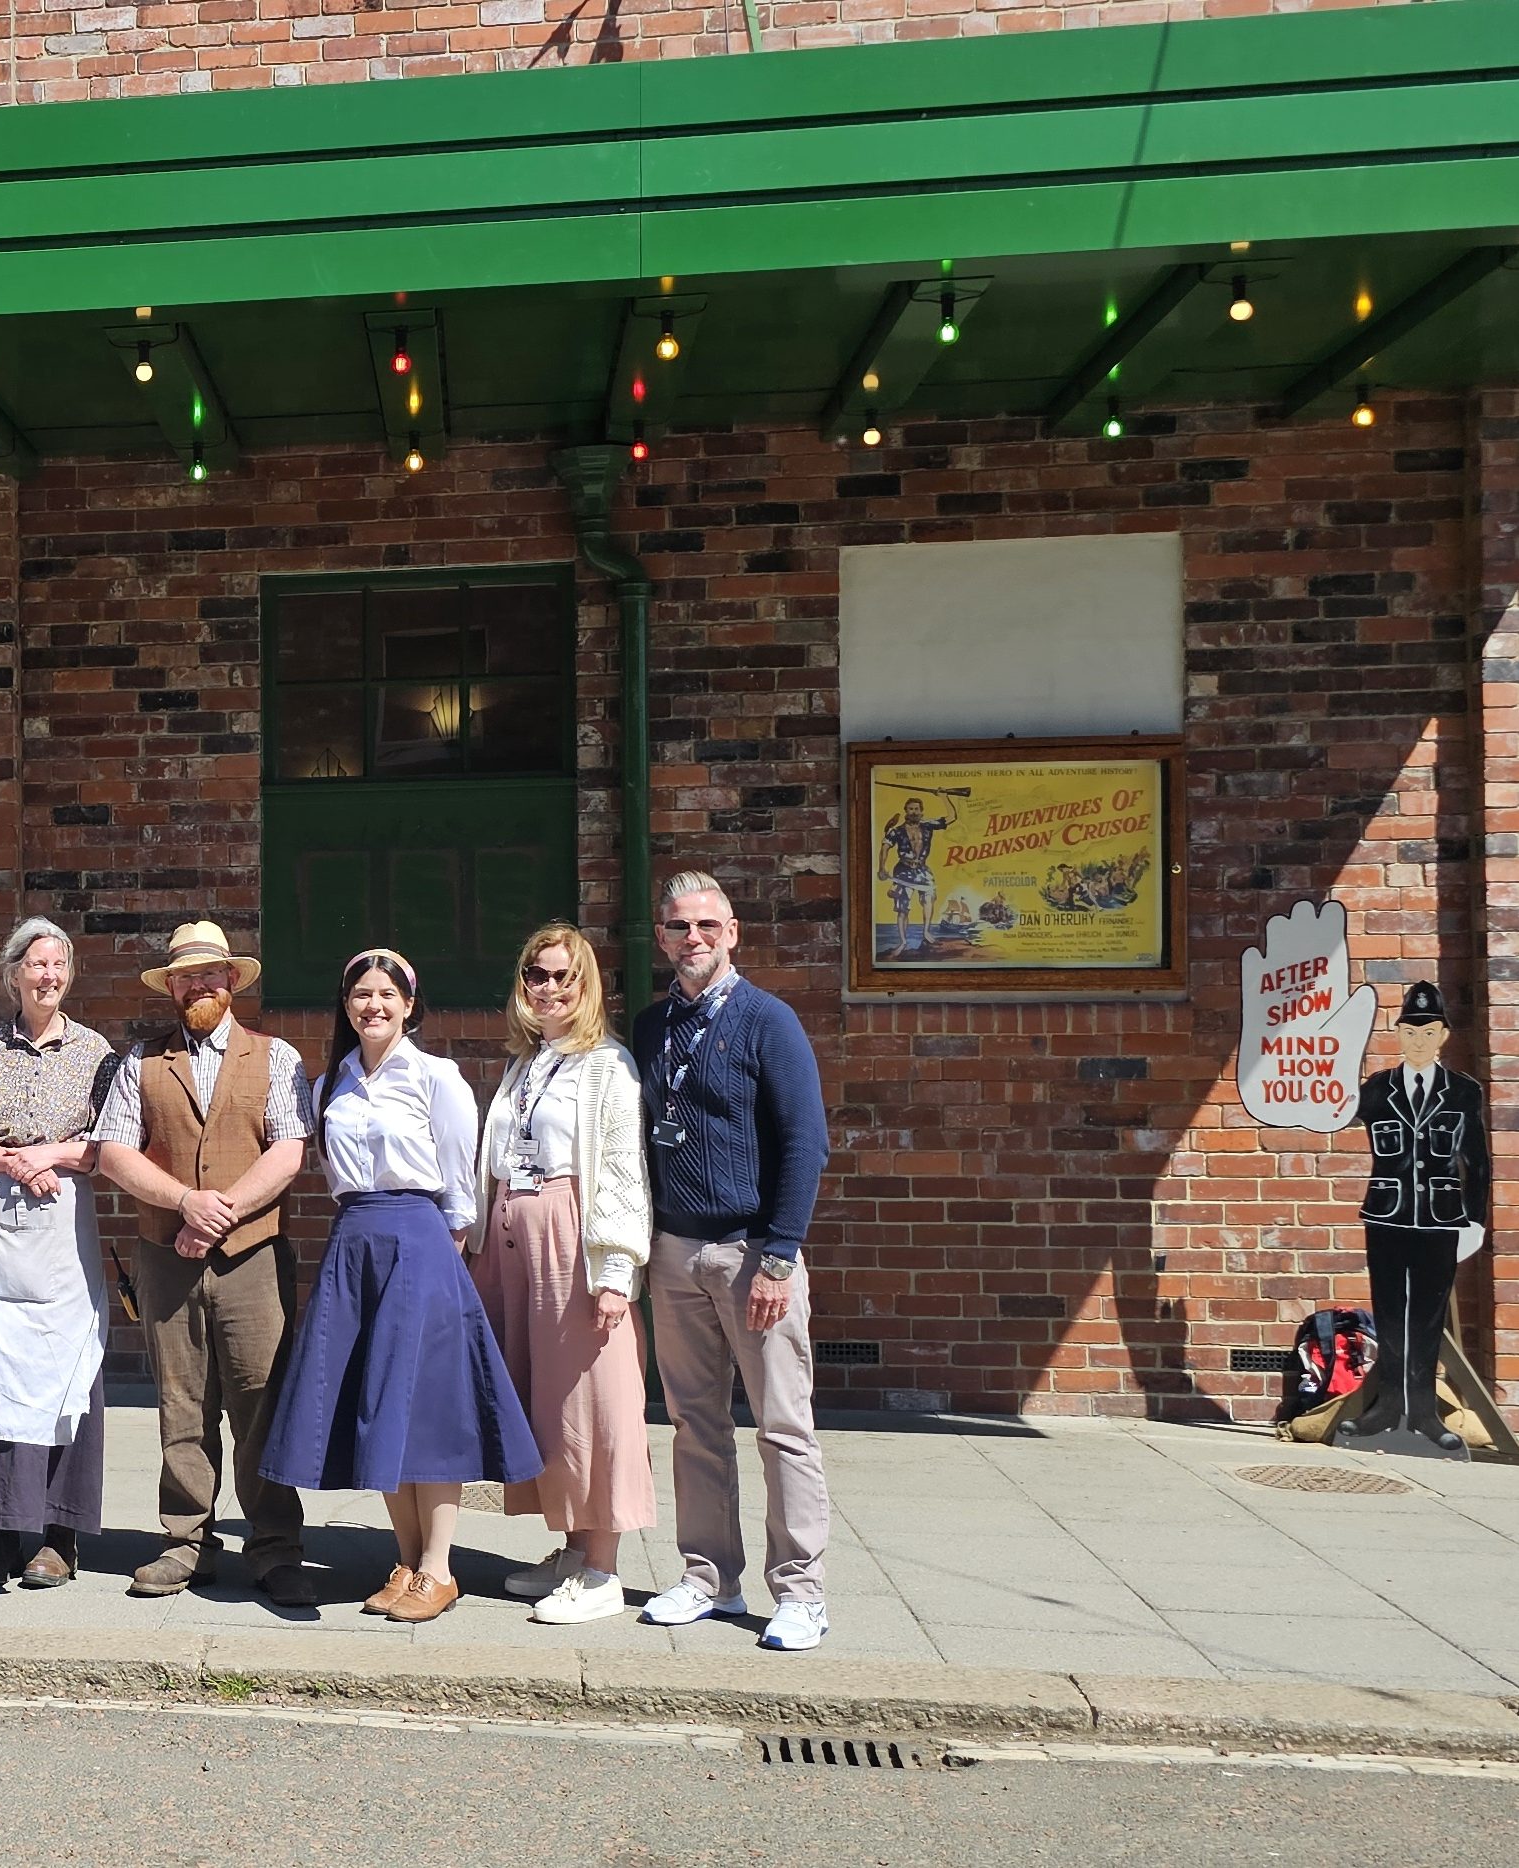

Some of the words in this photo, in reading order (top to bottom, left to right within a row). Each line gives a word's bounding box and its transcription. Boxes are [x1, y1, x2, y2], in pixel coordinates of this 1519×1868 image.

[911, 771, 935, 779] MOST
[939, 770, 983, 778] FABULOUS
[988, 769, 1013, 777] HERO
[1029, 768, 1044, 776] ALL
[1048, 768, 1097, 776] ADVENTURE
[984, 797, 1103, 837] ADVENTURES
[1112, 789, 1144, 811] OF
[943, 830, 1053, 867] ROBINSON
[1062, 814, 1151, 845] CRUSOE
[1020, 914, 1040, 926] DAN
[1045, 913, 1095, 926] O'HERLIHY
[1260, 956, 1329, 994] AFTER
[1281, 981, 1316, 998] THE
[1266, 987, 1333, 1027] SHOW
[1261, 1036, 1339, 1056] MIND
[1278, 1058, 1335, 1077] HOW
[1262, 1080, 1302, 1104] YOU
